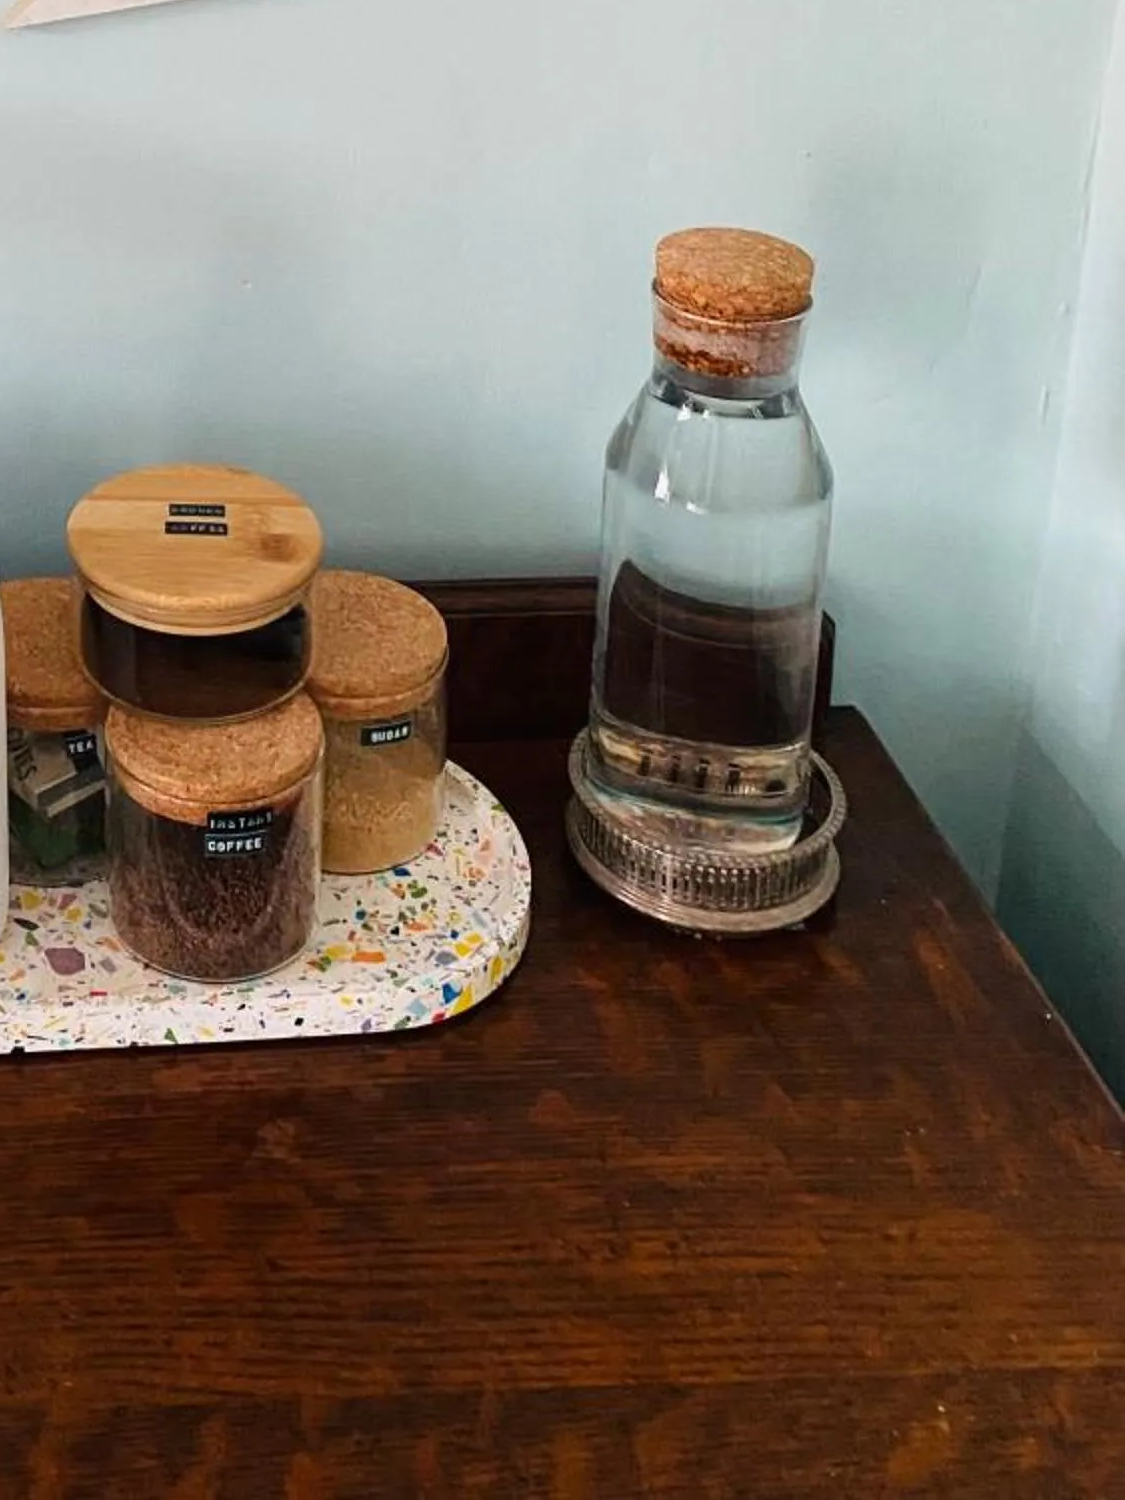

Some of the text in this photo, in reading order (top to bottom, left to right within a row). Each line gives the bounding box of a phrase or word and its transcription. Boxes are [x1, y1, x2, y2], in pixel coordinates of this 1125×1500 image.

[370, 725, 410, 743] SUGAR
[68, 739, 94, 754] TEA
[208, 837, 262, 852] COFFEE
